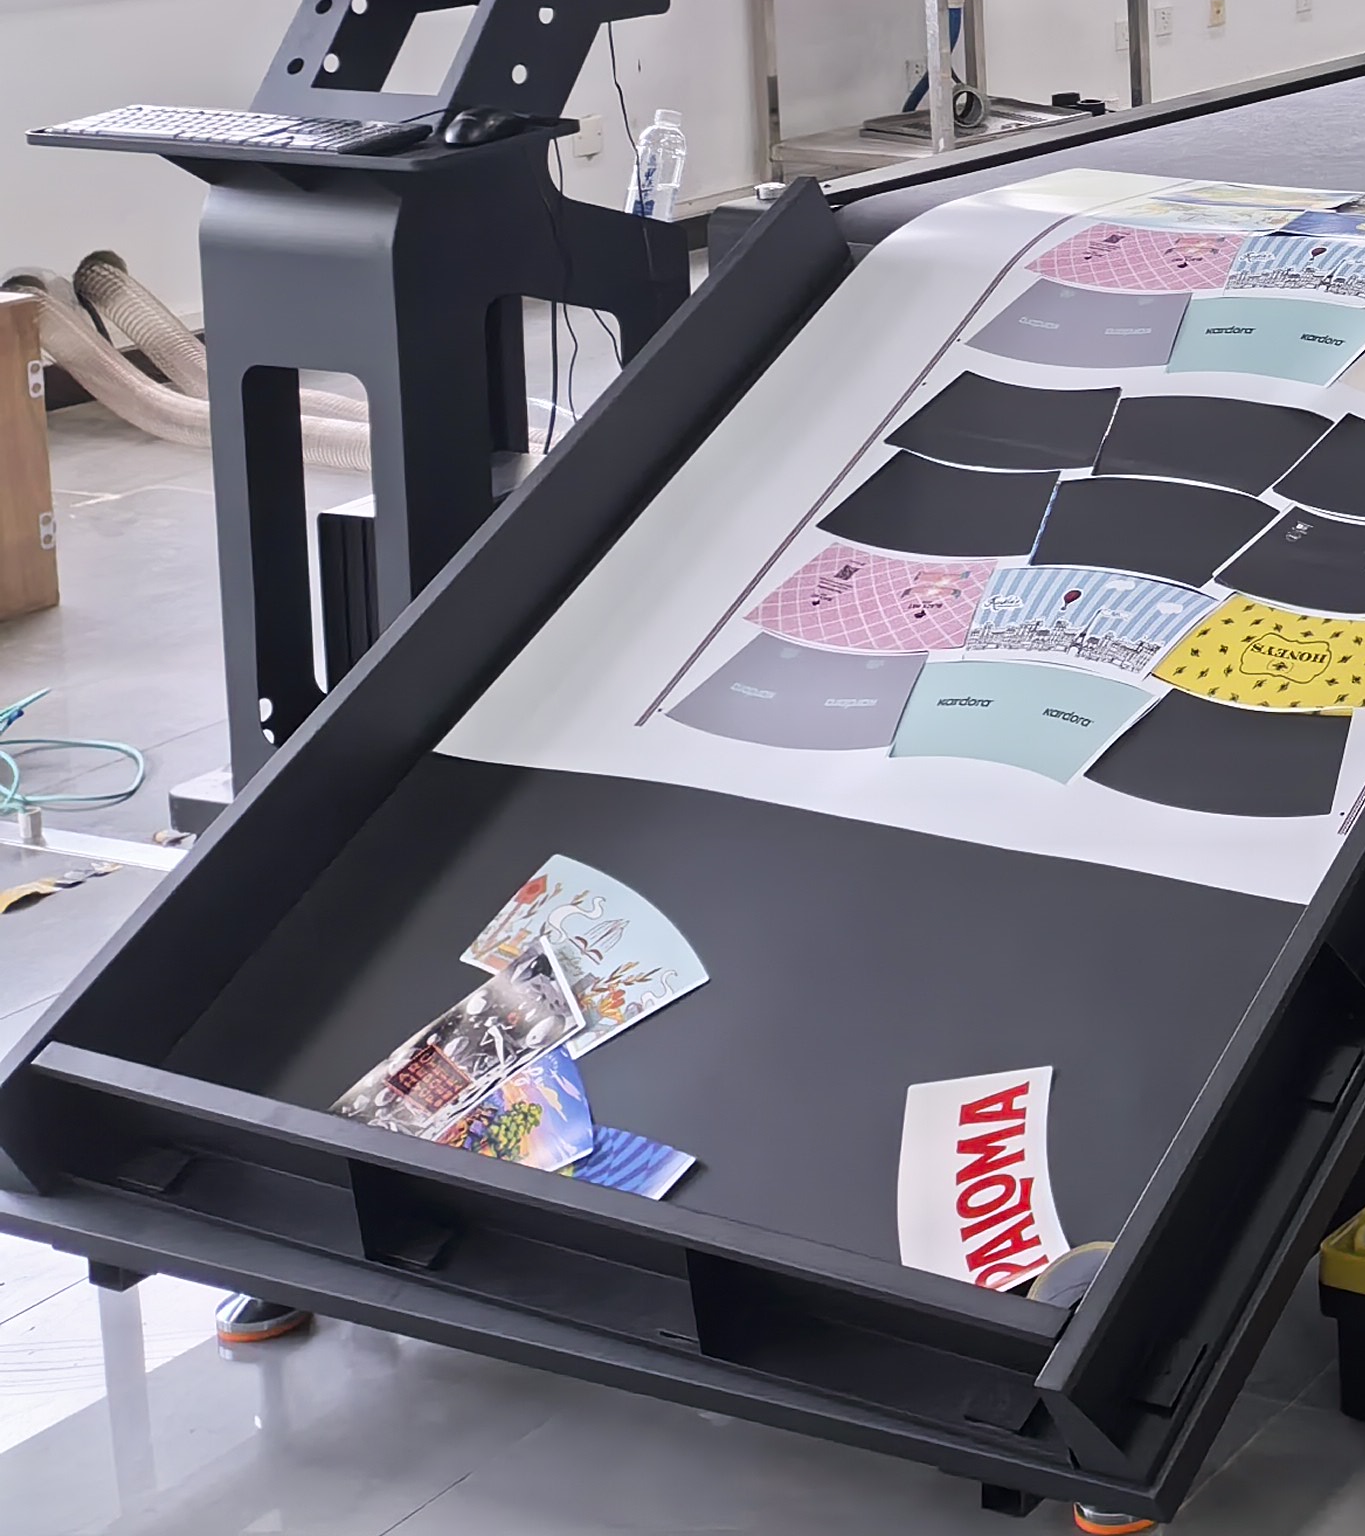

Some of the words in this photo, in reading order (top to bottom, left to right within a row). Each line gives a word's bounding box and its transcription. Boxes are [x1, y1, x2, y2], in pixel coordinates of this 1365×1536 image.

[1205, 325, 1256, 335] kardora
[1300, 333, 1346, 347] kardora
[937, 696, 994, 707] kardora
[1042, 708, 1094, 728] kardora
